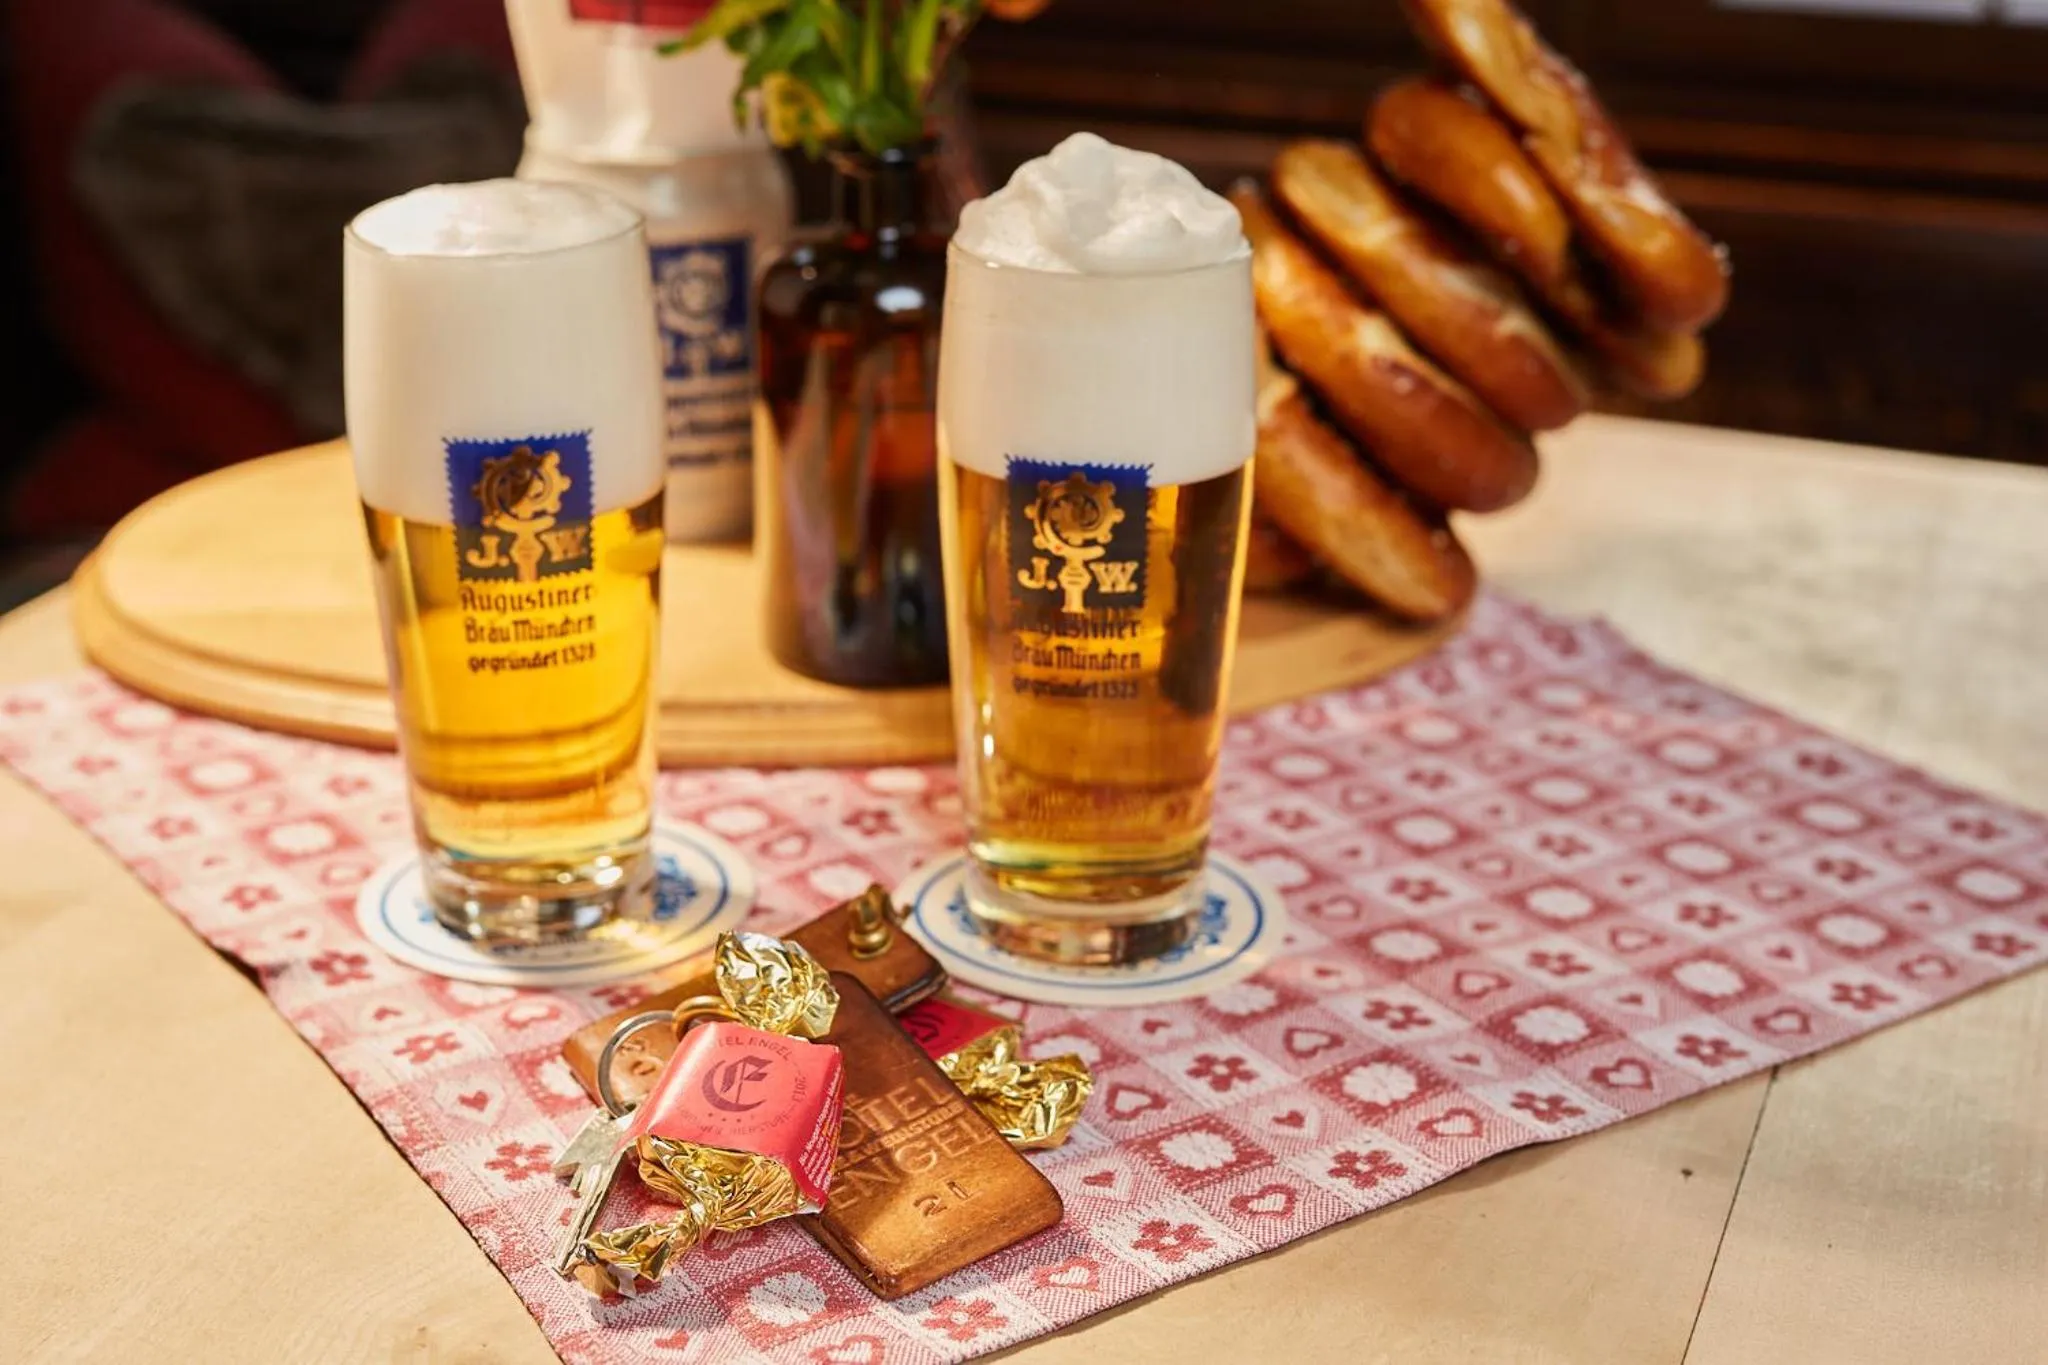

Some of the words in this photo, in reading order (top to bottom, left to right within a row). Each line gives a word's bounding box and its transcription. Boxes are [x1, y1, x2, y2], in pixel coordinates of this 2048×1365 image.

[465, 535, 510, 568] J.
[1017, 557, 1058, 590] J.
[1089, 561, 1139, 593] W.
[461, 583, 593, 615] Augustiner
[1056, 644, 1141, 670] München
[839, 1077, 955, 1148] OTEL
